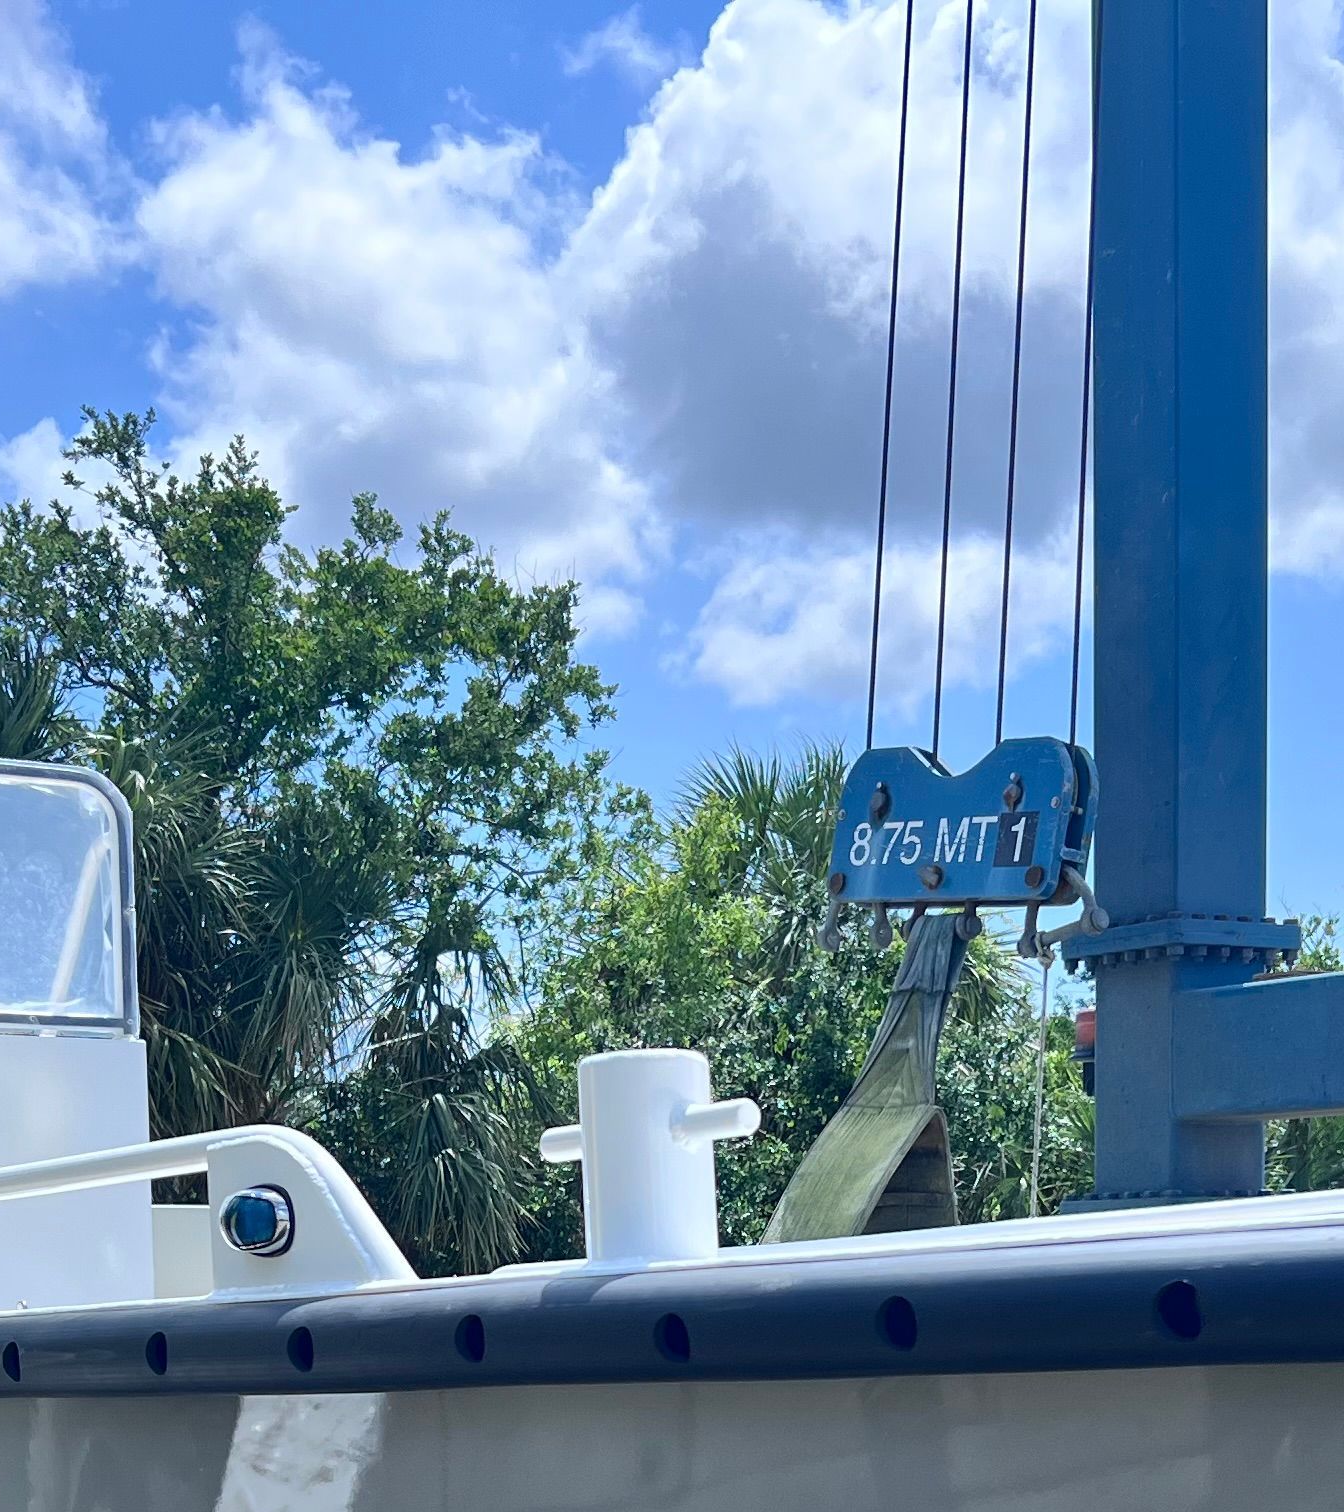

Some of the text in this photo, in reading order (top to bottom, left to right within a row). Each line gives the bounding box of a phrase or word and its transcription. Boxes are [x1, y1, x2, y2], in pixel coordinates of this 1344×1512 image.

[849, 815, 1026, 866] 8.75 MT 1
